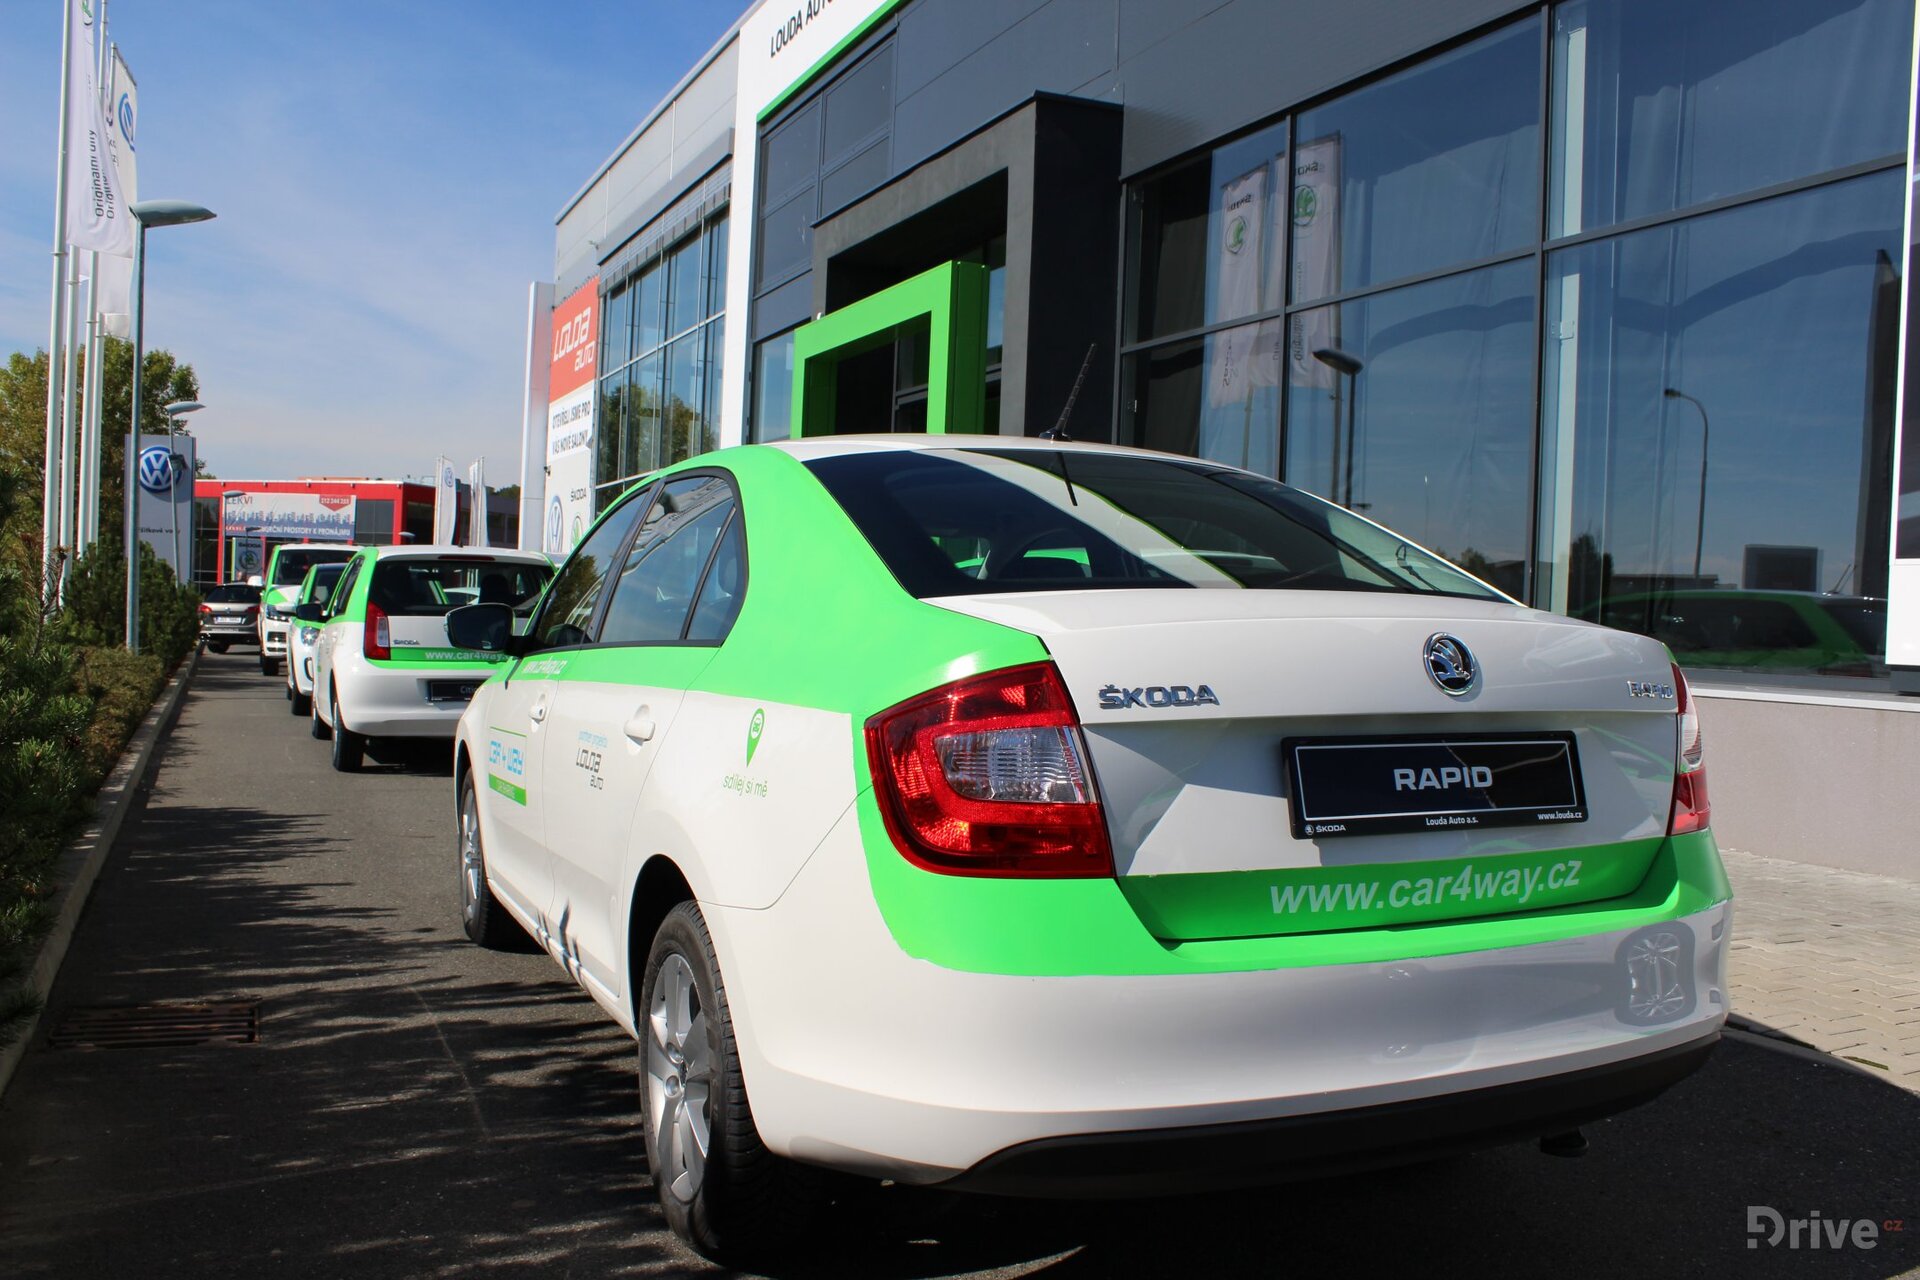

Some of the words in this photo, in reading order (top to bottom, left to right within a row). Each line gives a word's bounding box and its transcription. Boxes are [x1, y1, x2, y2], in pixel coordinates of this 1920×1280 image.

[770, 10, 802, 58] LOUDA
[1098, 684, 1220, 709] ŠKODA
[1626, 680, 1674, 699] RAPID
[1393, 765, 1494, 792] RAPID
[1426, 816, 1448, 826] Louda
[1448, 816, 1466, 825] Auto
[1466, 816, 1479, 824] a.s.
[1537, 811, 1583, 821] www.louda.cz
[1315, 824, 1346, 833] ŠKODA
[1270, 860, 1583, 915] www.car4way.cz
